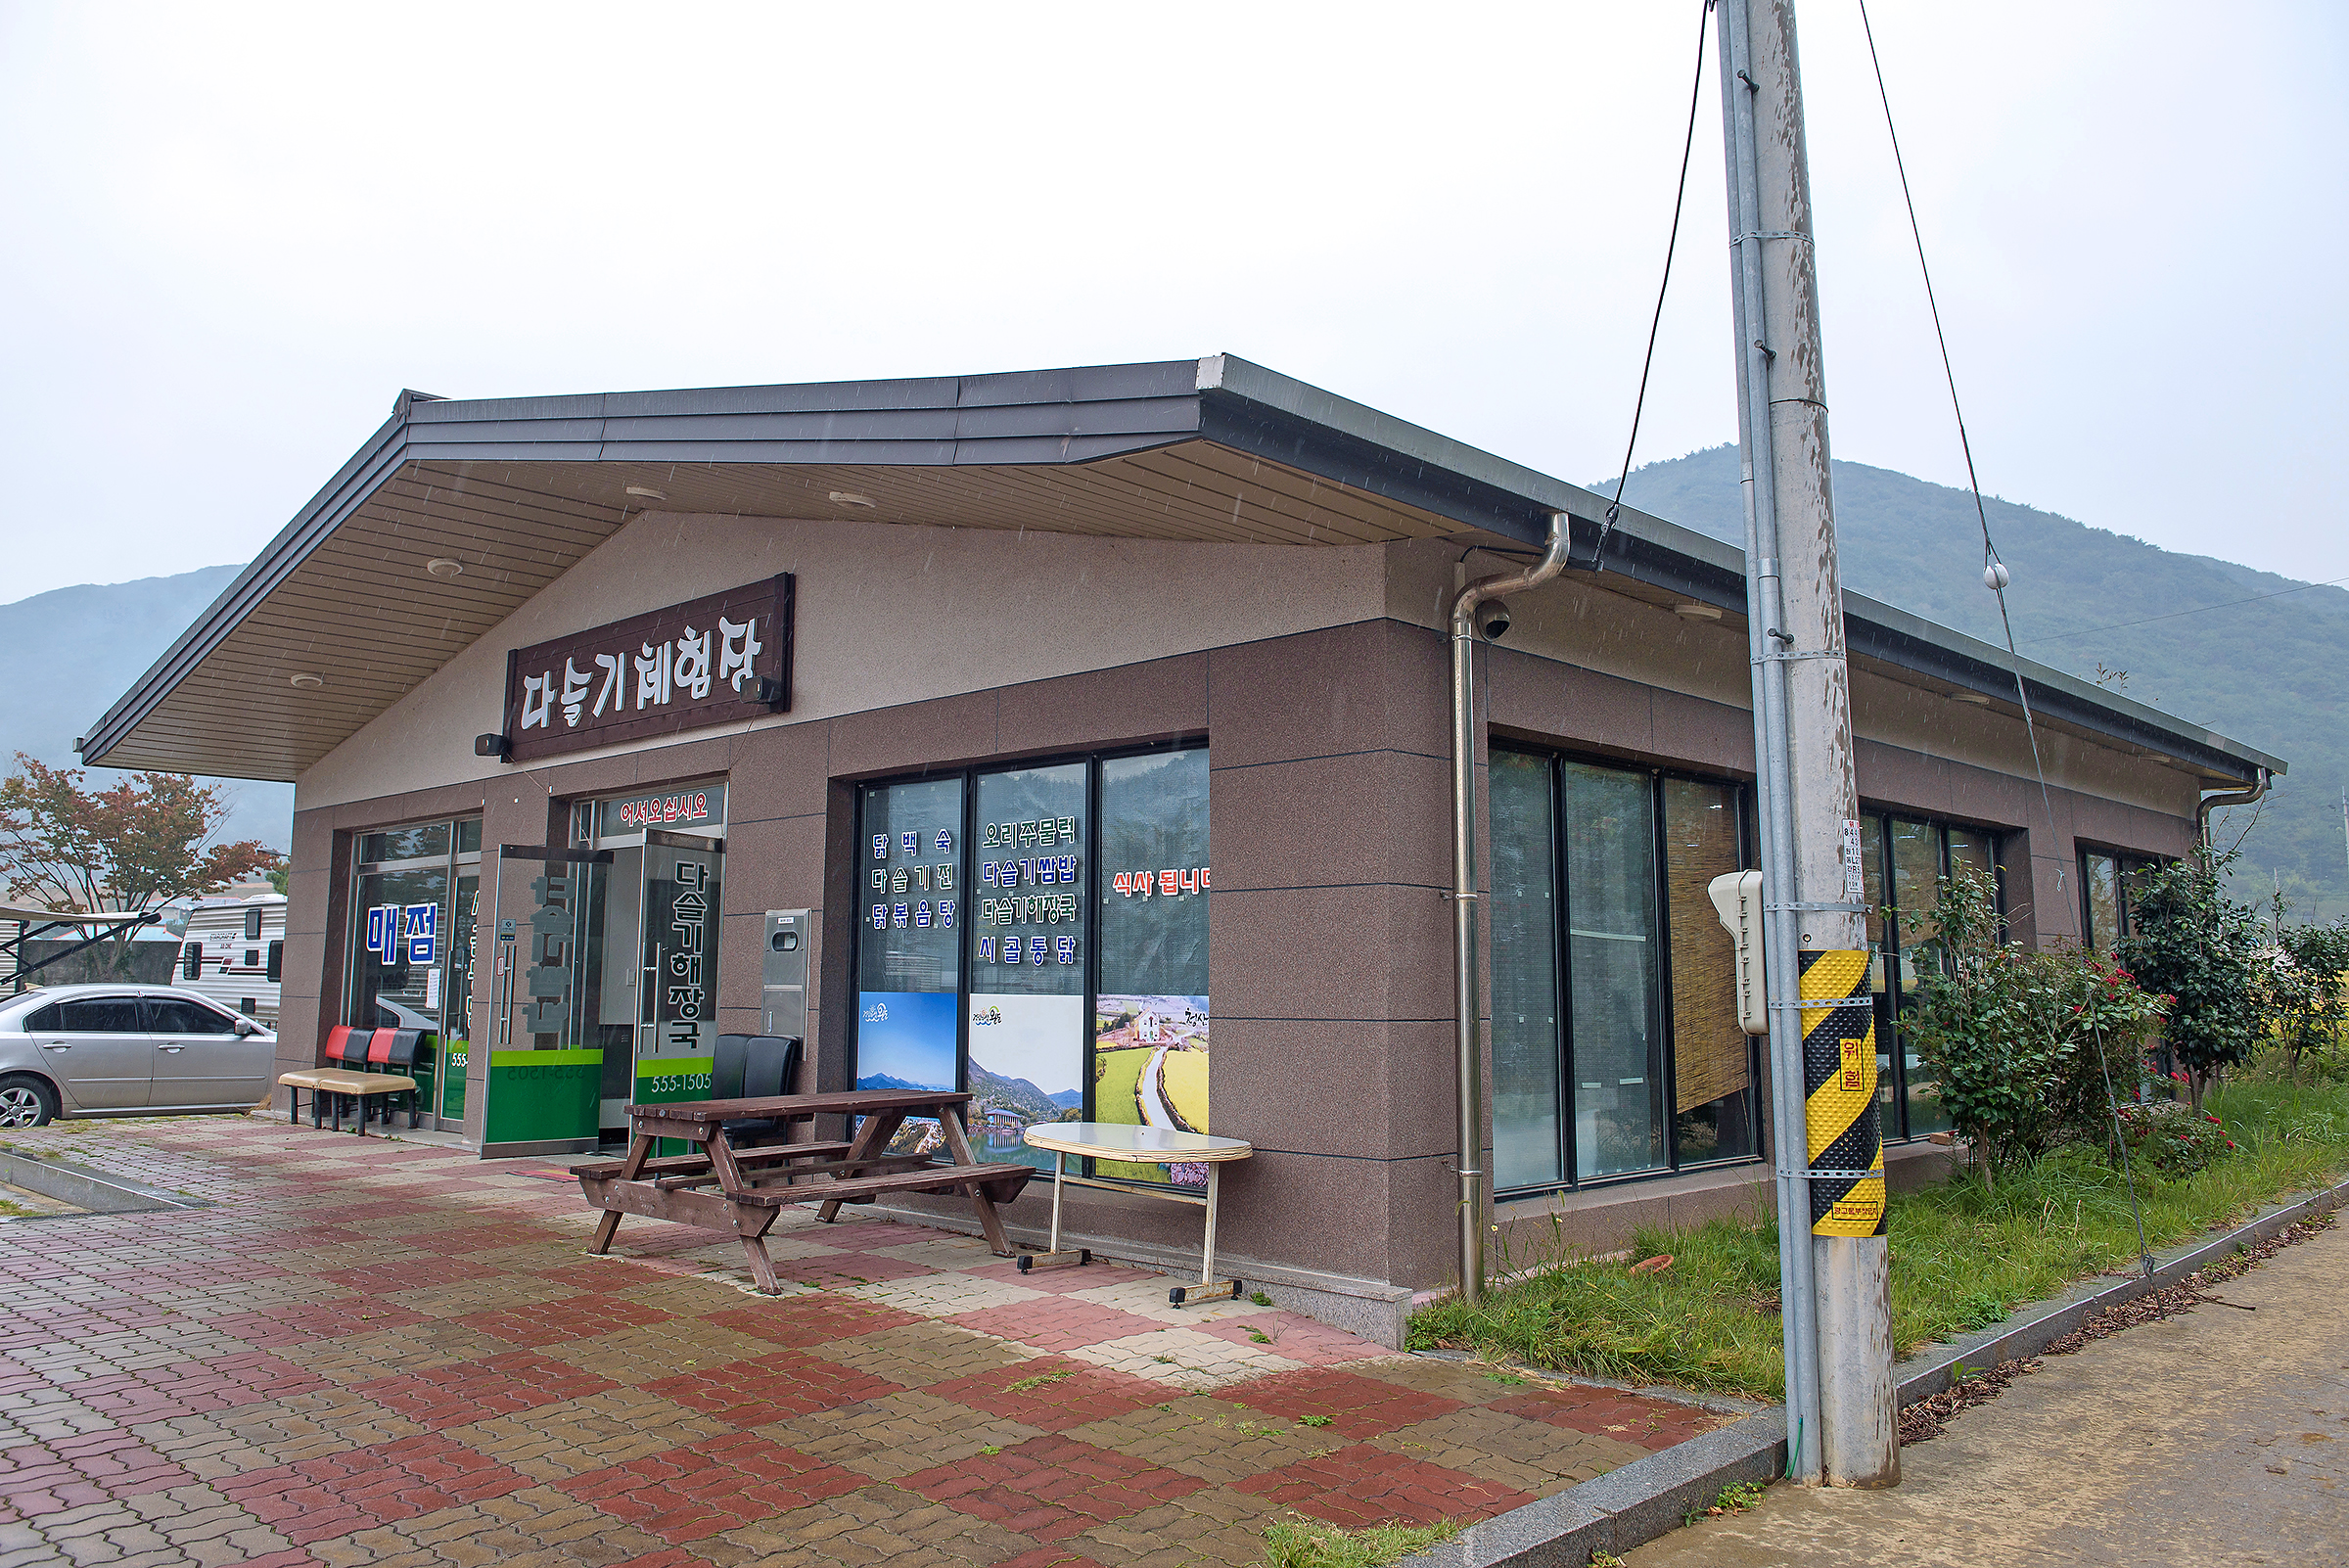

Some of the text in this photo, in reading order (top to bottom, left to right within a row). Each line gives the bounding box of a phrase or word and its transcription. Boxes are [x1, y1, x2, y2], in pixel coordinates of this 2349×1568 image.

[982, 815, 1076, 849] 오리주물럭
[982, 854, 1077, 888] 다슬기쌈밥
[1113, 871, 1155, 898] 식사
[981, 893, 1077, 925] 다슬기해장국
[366, 901, 439, 966] 매점
[668, 860, 710, 1049] 다슬기해장국
[1844, 1041, 1860, 1087] 위험
[651, 1073, 713, 1092] 555-1505
